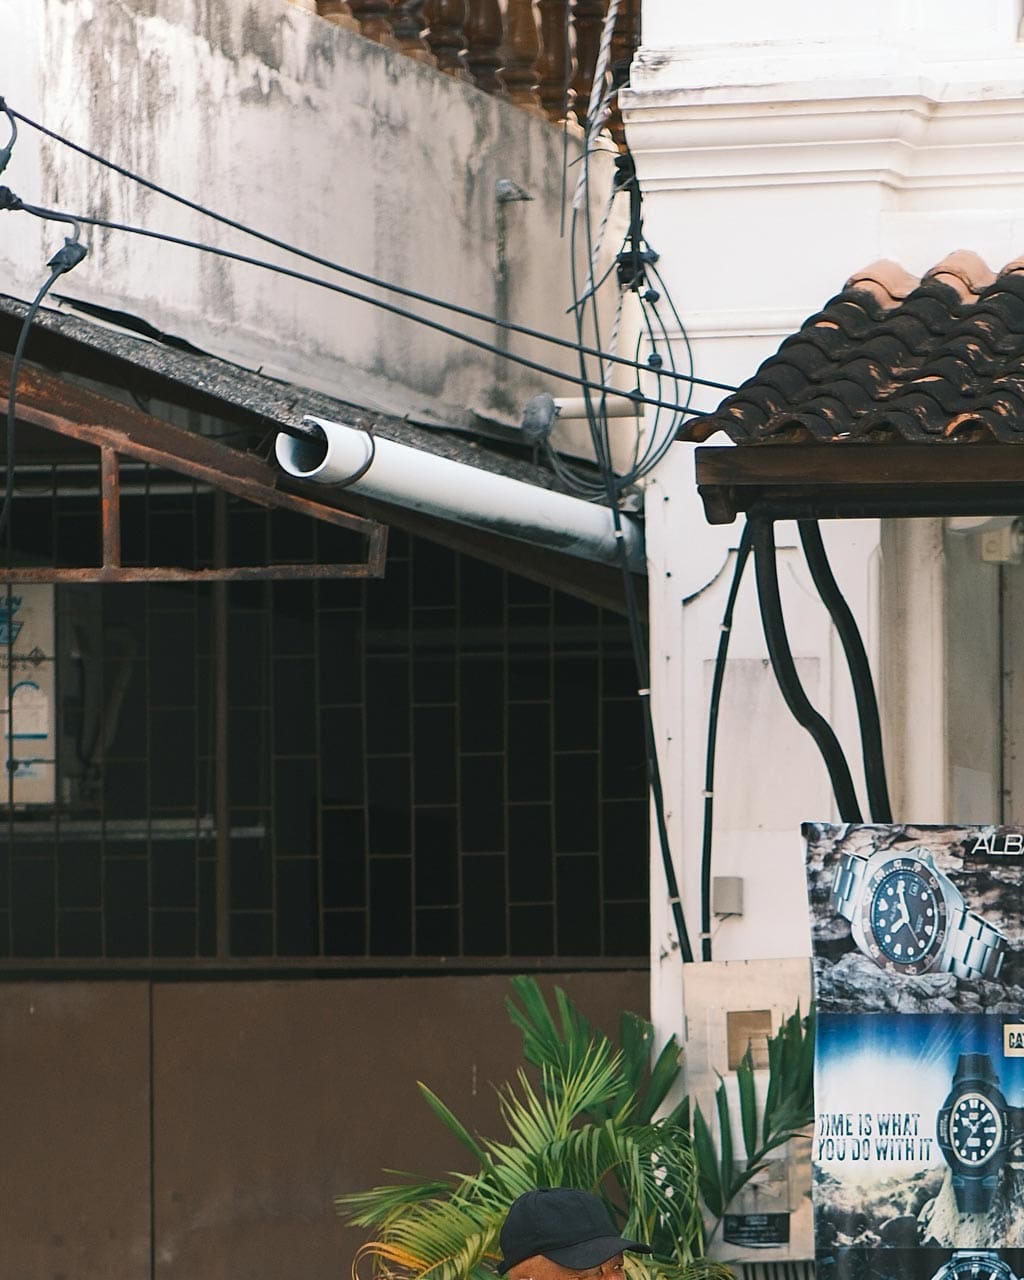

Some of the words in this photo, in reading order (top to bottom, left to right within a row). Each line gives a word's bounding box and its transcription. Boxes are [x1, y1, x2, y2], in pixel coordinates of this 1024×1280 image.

[819, 1113, 854, 1137] TIME
[858, 1113, 873, 1136] IS
[877, 1113, 921, 1136] WHAT
[818, 1138, 847, 1161] YOU
[851, 1138, 871, 1161] DO
[875, 1139, 917, 1161] WITH
[919, 1138, 933, 1161] IT
